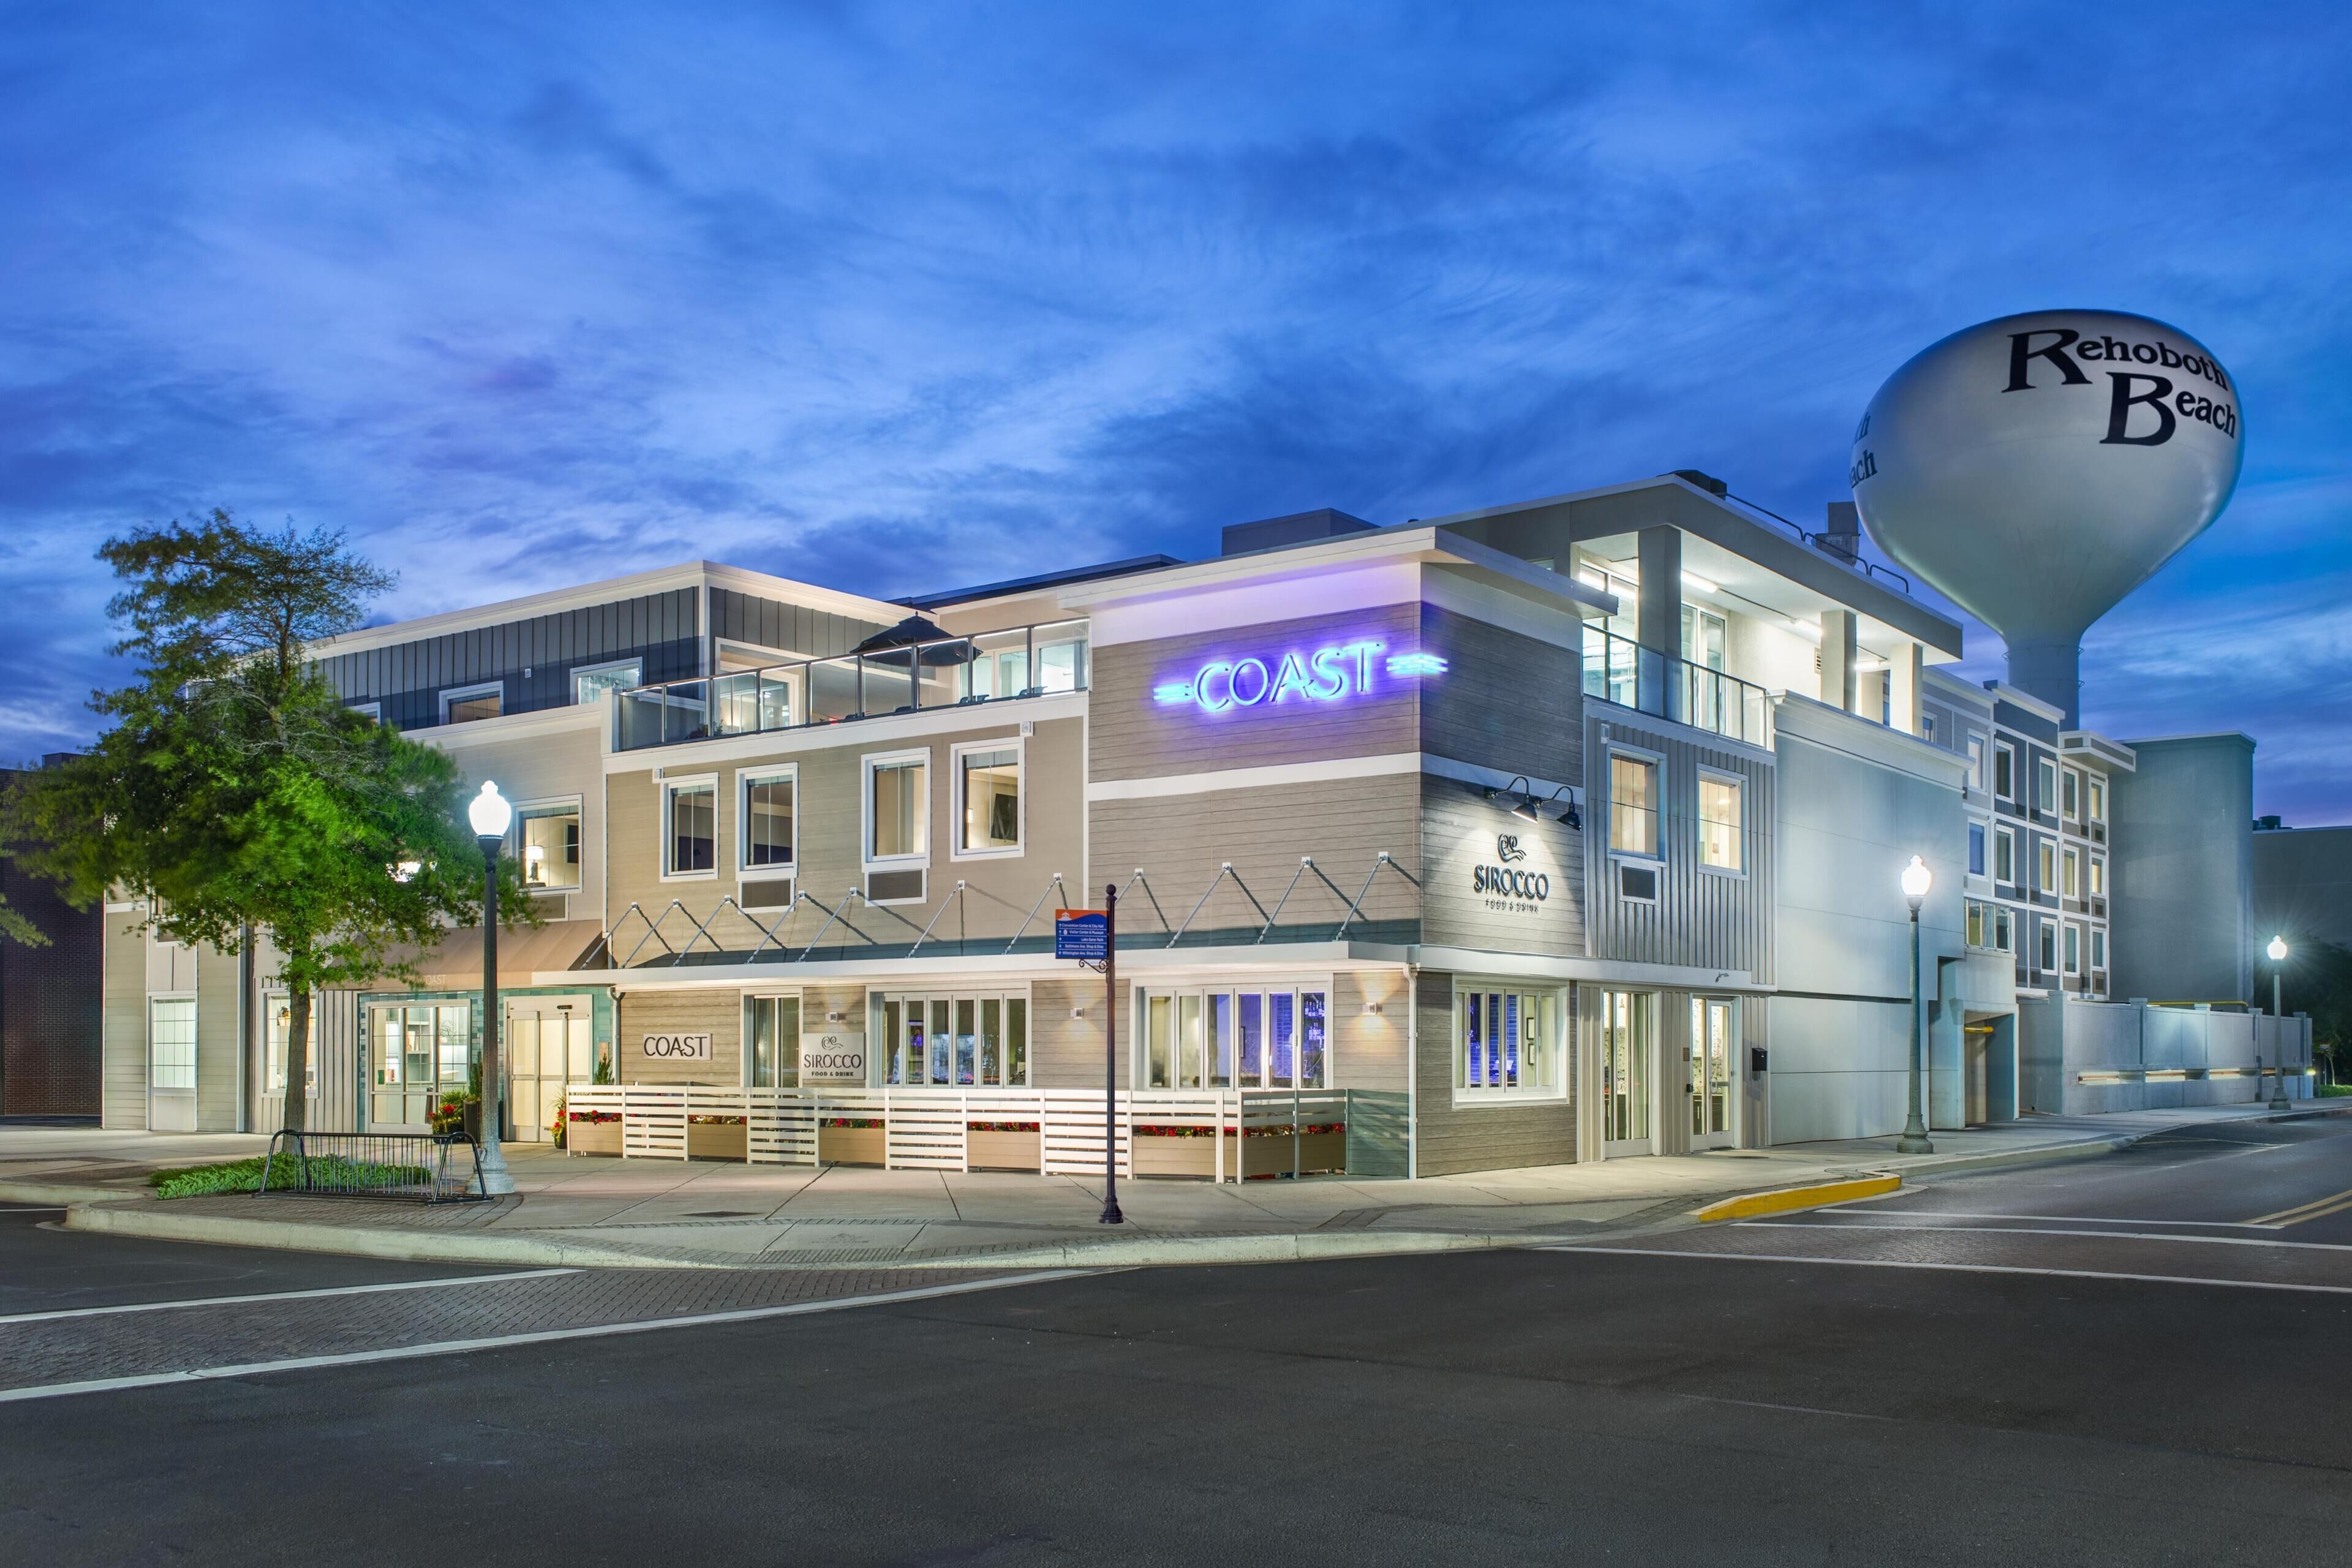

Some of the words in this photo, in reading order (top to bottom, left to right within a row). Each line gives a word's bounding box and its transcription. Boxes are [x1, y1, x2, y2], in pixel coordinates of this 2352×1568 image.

[2002, 328, 2228, 393] Rehoboth
[2099, 371, 2236, 446] Beach
[1849, 449, 1878, 488] ach
[1194, 641, 1384, 711] COAST
[1474, 864, 1549, 901] SIROCCO
[1485, 898, 1507, 910] FOOD
[1516, 902, 1539, 914] DRINK
[644, 1036, 708, 1057] COAST
[804, 1054, 862, 1068] SIROCCO
